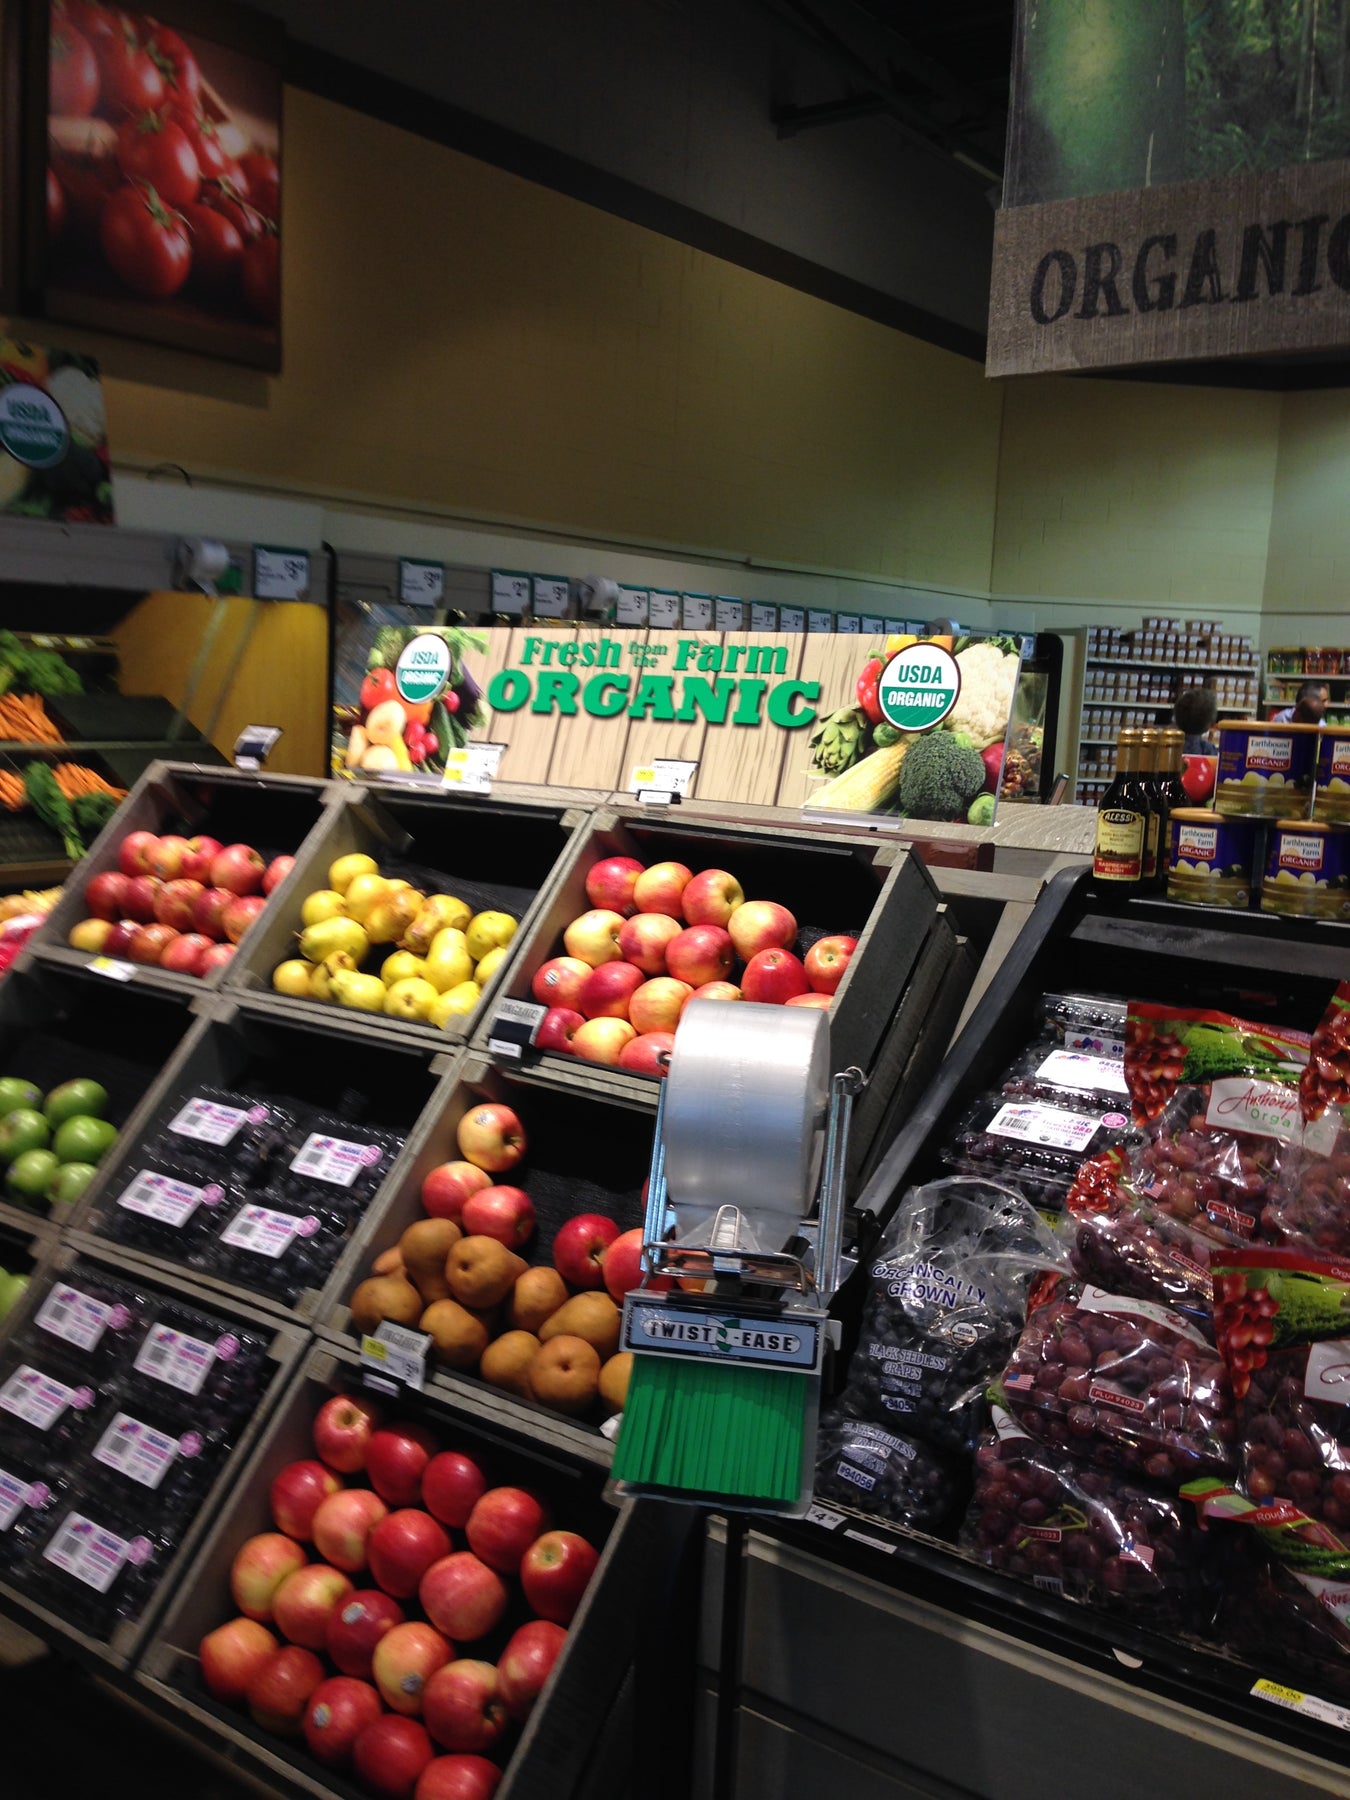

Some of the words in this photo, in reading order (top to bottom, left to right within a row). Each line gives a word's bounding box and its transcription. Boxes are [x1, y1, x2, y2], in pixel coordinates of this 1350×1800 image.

[519, 636, 622, 667] Fresh
[628, 641, 668, 655] from
[411, 651, 439, 665] USDA
[633, 655, 659, 667] the
[672, 639, 789, 675] Farm
[897, 664, 943, 684] USDA
[487, 668, 821, 728] ORGANIC
[887, 690, 946, 708] ORGANIC
[1251, 739, 1290, 749] Earthbound
[1250, 756, 1287, 767] ORGANIC
[1104, 812, 1134, 822] ALESSI
[1181, 828, 1214, 839] Earthbound
[1197, 838, 1214, 847] Farm
[1282, 838, 1320, 848] Earthbound
[1180, 845, 1212, 857] ORGANIC
[1302, 848, 1320, 857] Farm
[1282, 856, 1317, 867] ORGANIC
[899, 1347, 947, 1371] SEEDLESS
[882, 1361, 923, 1381] GRAPES
[873, 1429, 917, 1461] SEEDLESS
[839, 1464, 874, 1489] #94056
